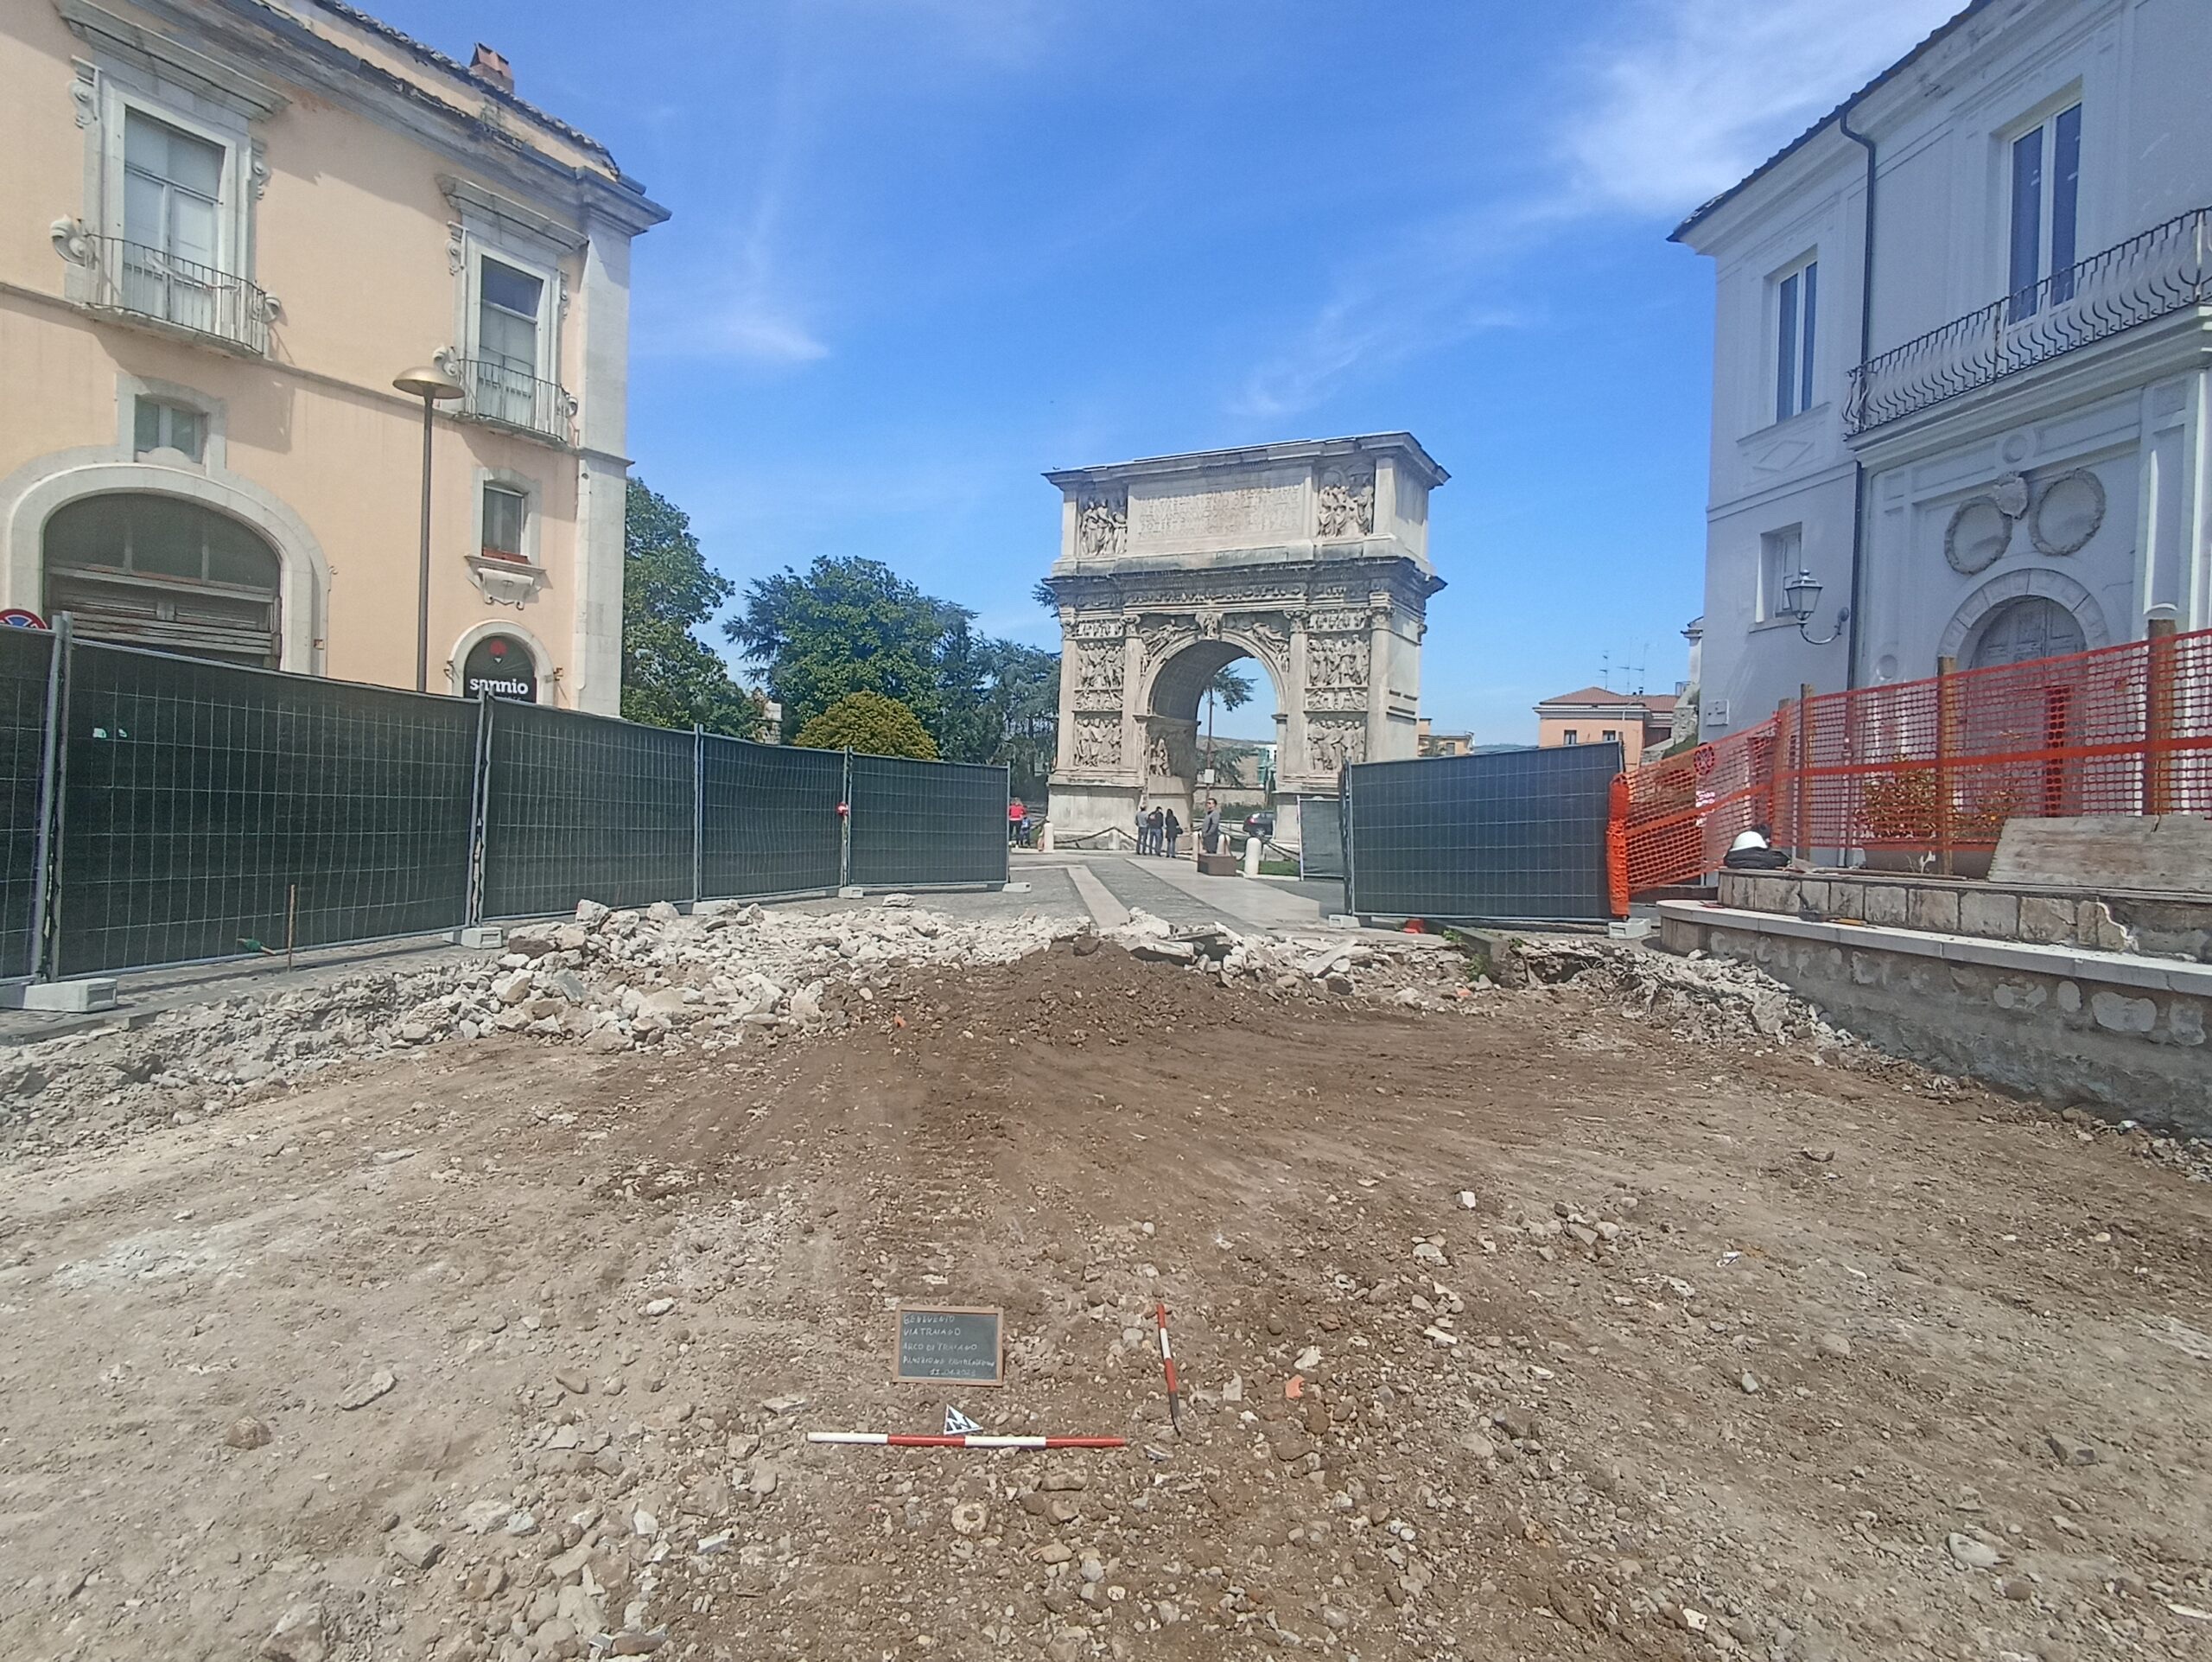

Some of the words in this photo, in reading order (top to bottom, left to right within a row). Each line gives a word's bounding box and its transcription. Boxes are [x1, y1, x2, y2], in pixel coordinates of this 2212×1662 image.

[920, 1328, 962, 1336] TRAIANO
[903, 1342, 924, 1351] ARCO
[926, 1343, 935, 1352] DI
